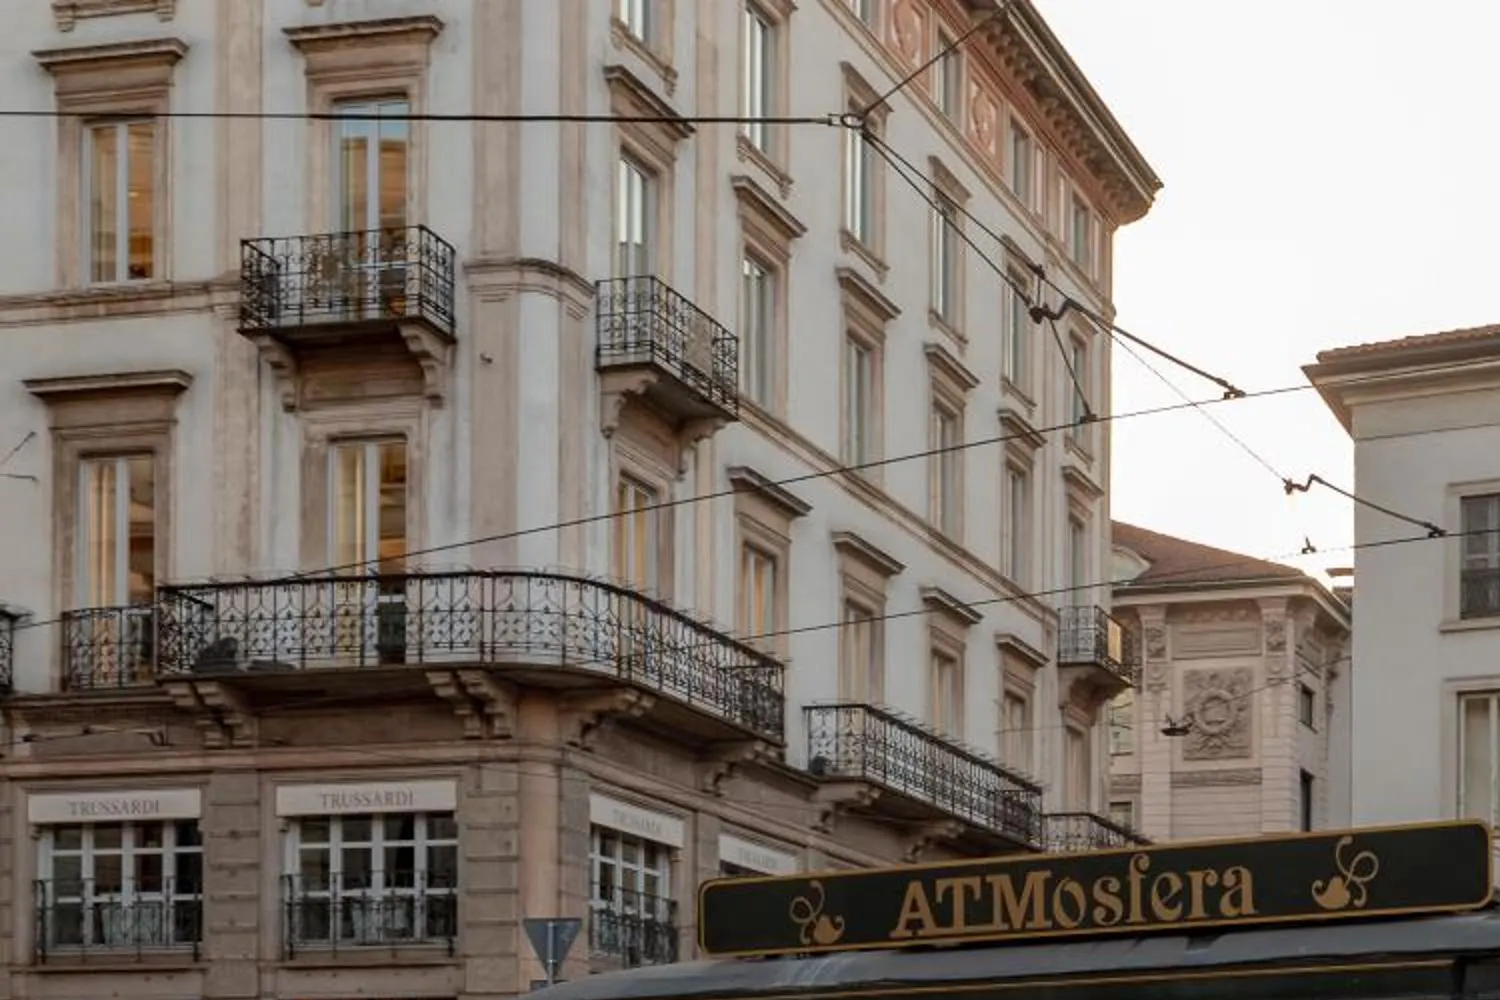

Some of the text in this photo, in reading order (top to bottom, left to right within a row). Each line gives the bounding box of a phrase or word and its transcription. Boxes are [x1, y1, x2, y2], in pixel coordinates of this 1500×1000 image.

[67, 799, 160, 817] TRUSSARDI
[320, 789, 414, 809] TRUSSARDI
[889, 853, 1258, 939] ATMosfera
